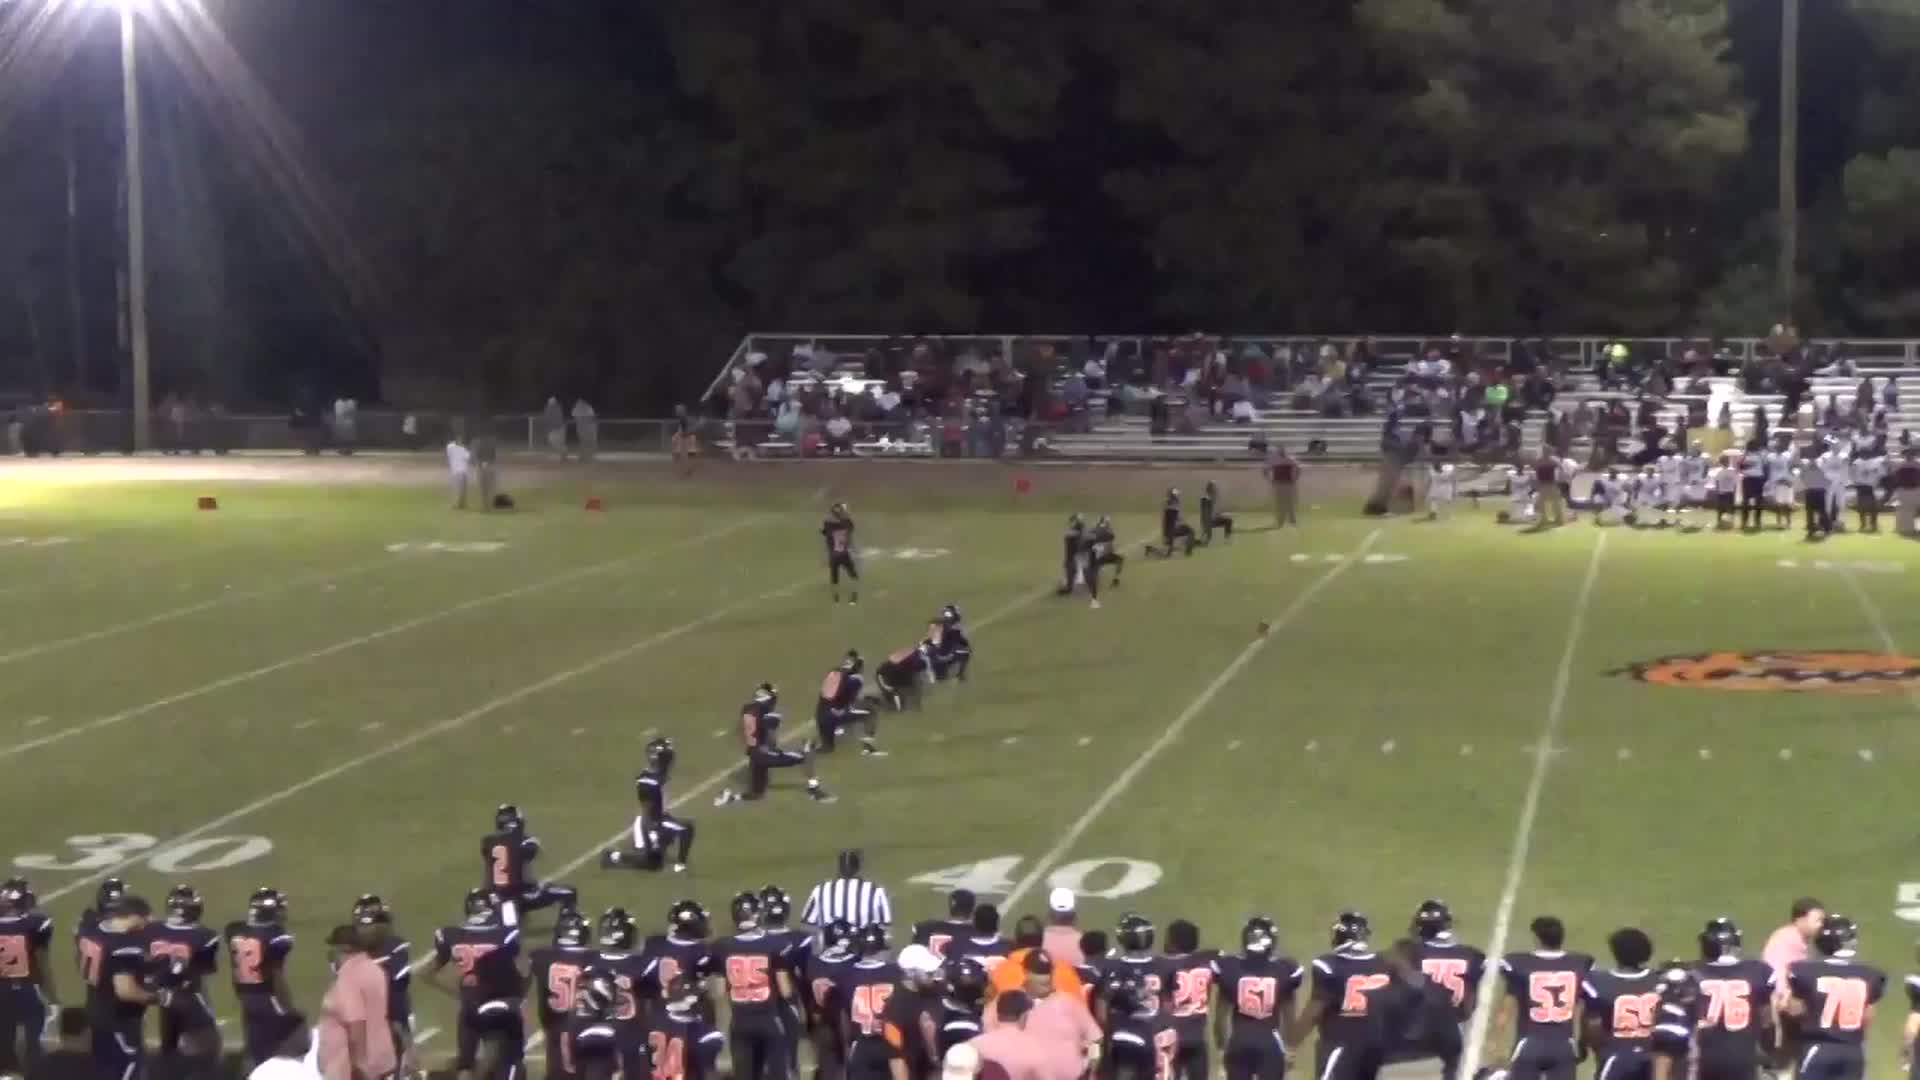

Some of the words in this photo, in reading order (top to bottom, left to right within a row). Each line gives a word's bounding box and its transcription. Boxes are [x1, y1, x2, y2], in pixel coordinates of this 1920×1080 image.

[12, 832, 274, 873] 30
[491, 844, 510, 890] 2
[907, 854, 1164, 899] 40
[1529, 970, 1578, 1023] 53
[1699, 978, 1751, 1031] 76
